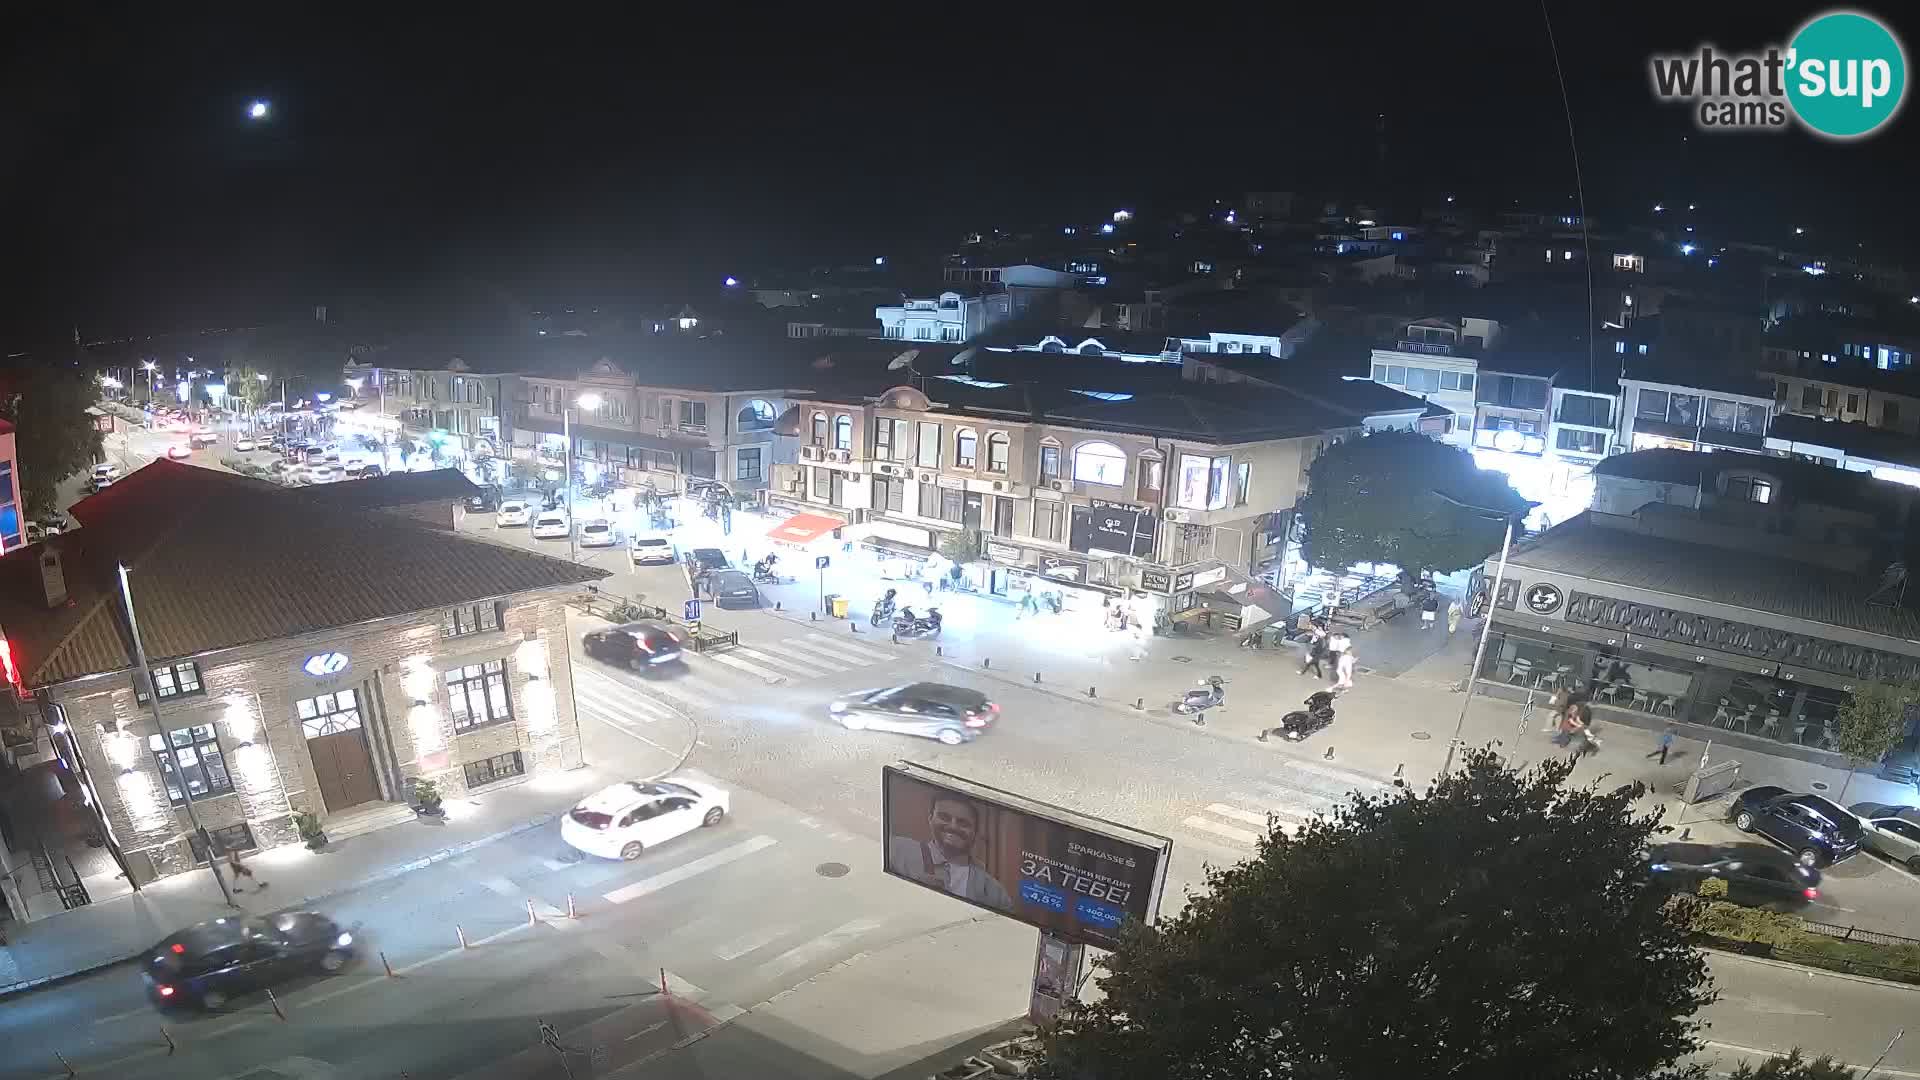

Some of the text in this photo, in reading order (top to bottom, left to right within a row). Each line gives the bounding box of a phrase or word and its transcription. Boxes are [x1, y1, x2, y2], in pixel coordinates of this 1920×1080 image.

[1068, 842, 1125, 865] SPARKASSE
[1020, 859, 1053, 884] ЗА
[1059, 869, 1132, 906] ТЕБЕ!
[1030, 892, 1062, 908] 4,5%
